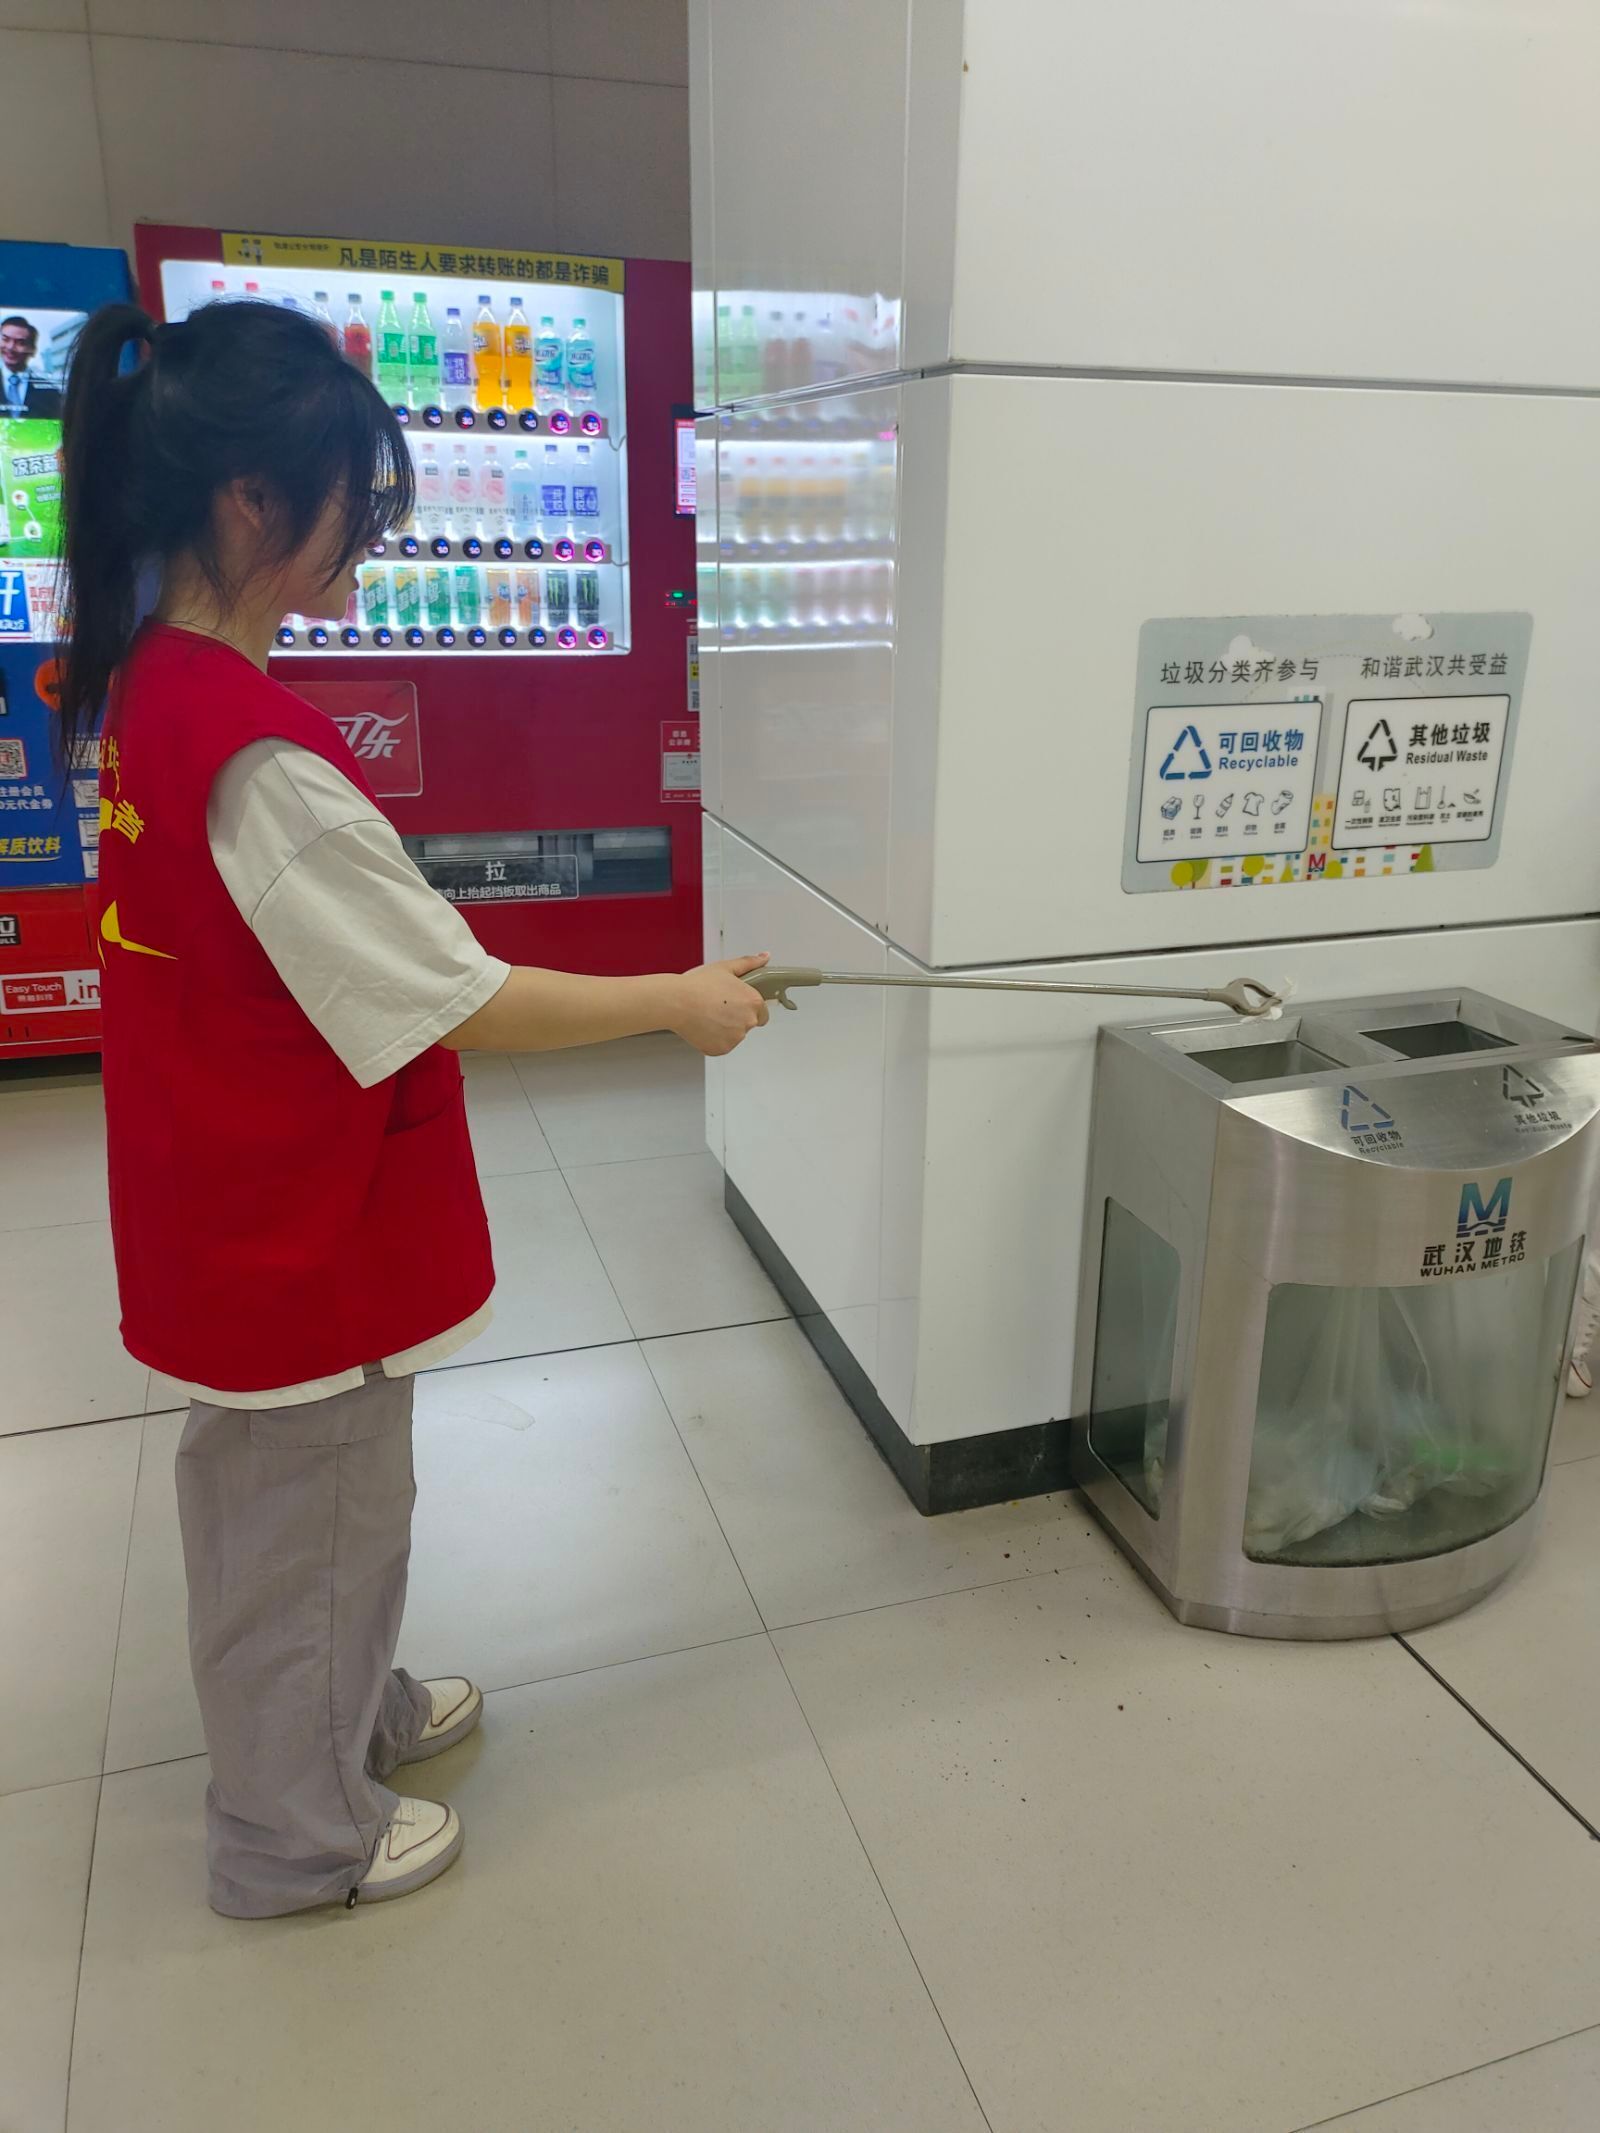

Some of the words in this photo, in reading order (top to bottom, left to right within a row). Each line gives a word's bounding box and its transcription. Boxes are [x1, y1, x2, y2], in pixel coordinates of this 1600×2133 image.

[339, 247, 609, 285] 凡是陌生人要求转账的都是诈骗
[1160, 658, 1319, 684] 垃圾分类齐参与
[1361, 653, 1508, 679] 和谐武汉共受益
[1218, 729, 1304, 754] 可回收物
[1409, 722, 1491, 747] 其他垃圾
[1218, 755, 1298, 771] Recyclable
[1406, 751, 1453, 765] Residual
[1456, 749, 1488, 762] Waste
[485, 861, 507, 882] 拉
[5, 984, 30, 995] Easy
[31, 982, 62, 992] Touch
[1513, 1111, 1561, 1125] 其他垃圾
[1351, 1131, 1402, 1146] 可回收物
[1359, 1142, 1404, 1154] Recyclable
[1422, 1231, 1527, 1266] 武汉地铁
[1420, 1263, 1476, 1278] WUHAN
[1481, 1252, 1525, 1270] METRO
